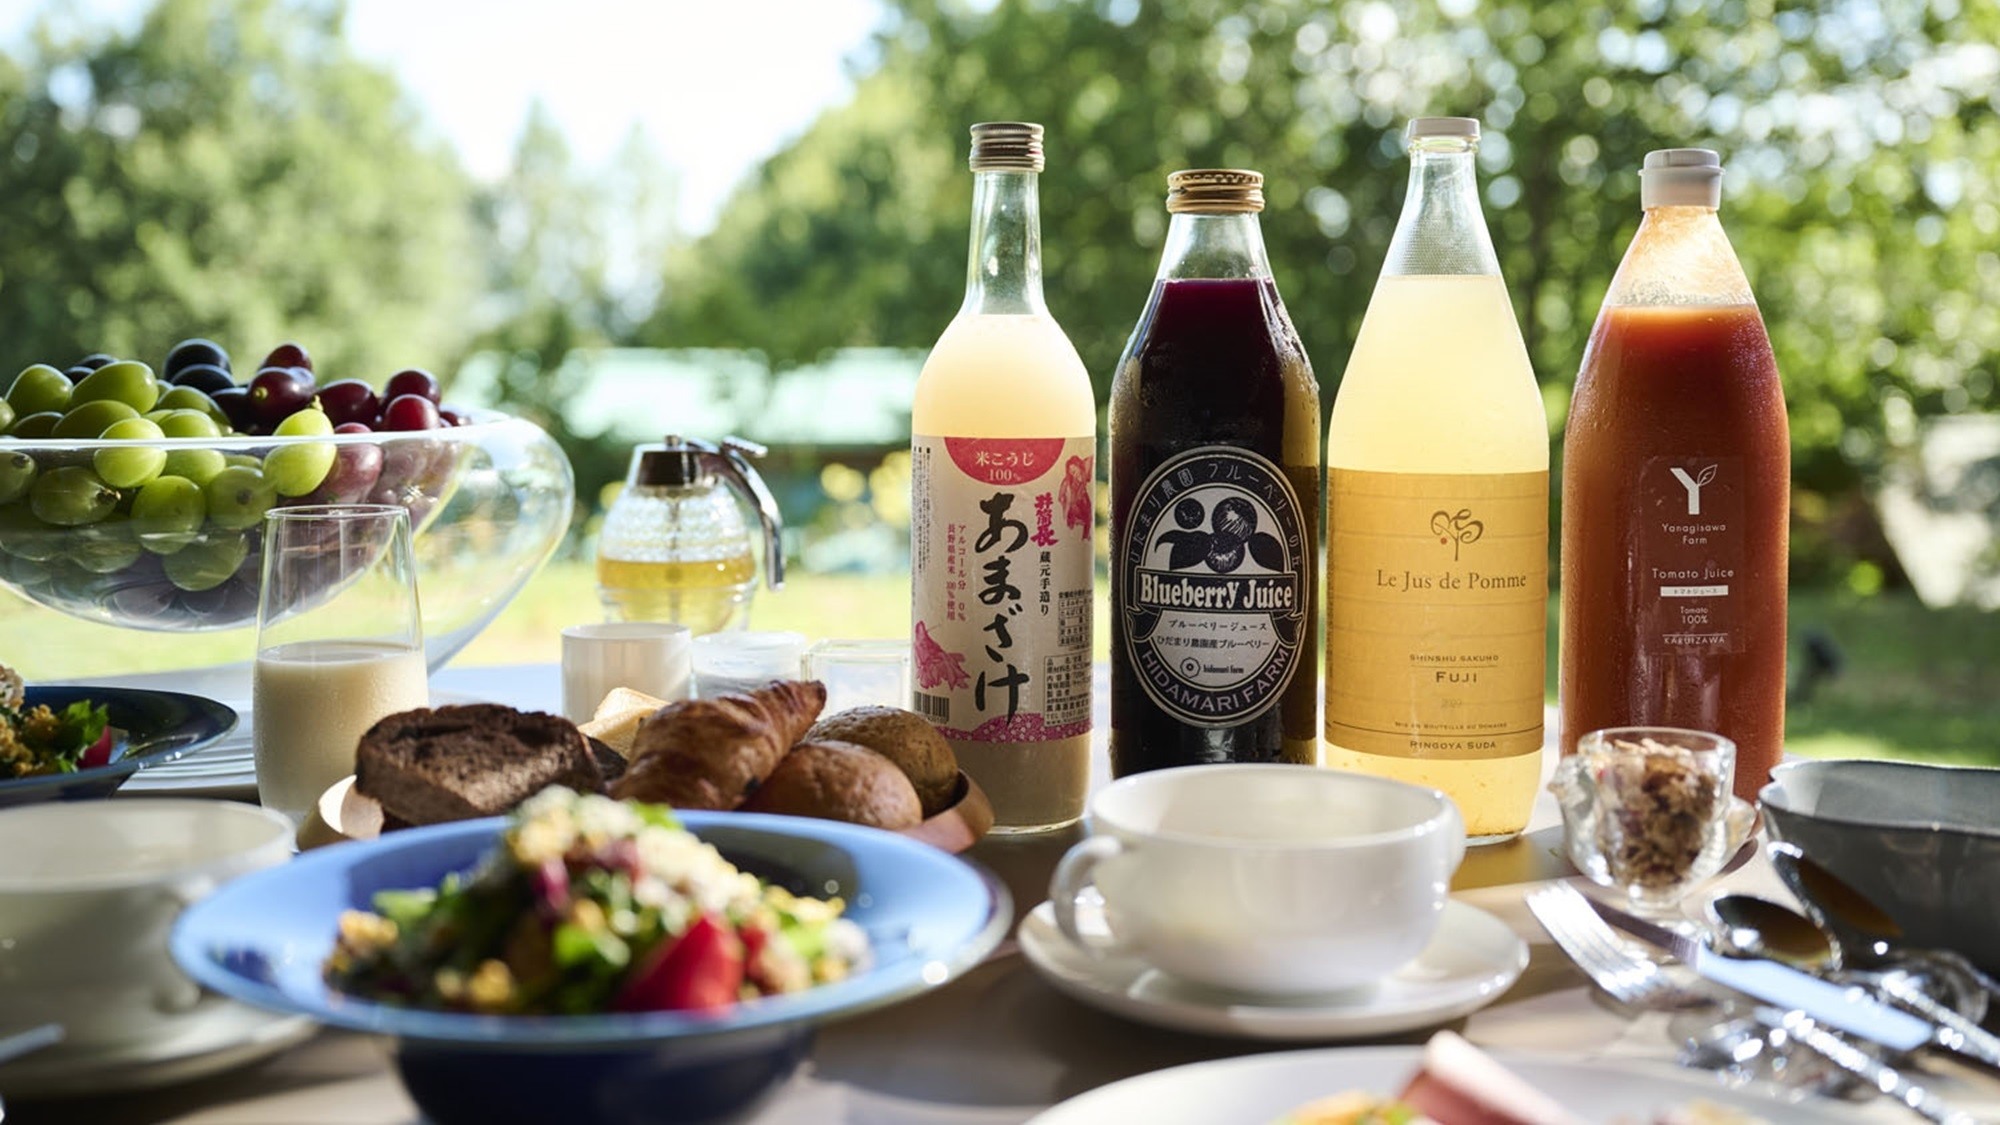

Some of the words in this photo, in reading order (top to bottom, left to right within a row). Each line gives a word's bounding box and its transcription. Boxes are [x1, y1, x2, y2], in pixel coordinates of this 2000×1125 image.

[975, 451, 1034, 467] 米こうじ
[988, 469, 1022, 482] 100%
[1661, 522, 1727, 534] Yanagisawa
[957, 525, 967, 589] アルコール分
[1651, 567, 1699, 579] Tomato
[1704, 567, 1735, 580] Juice
[1039, 551, 1051, 616] 蔵元手造り
[1376, 569, 1397, 587] Le
[1402, 570, 1432, 592] Jus
[1439, 571, 1461, 590] de
[1468, 572, 1527, 590] Pomme
[1243, 579, 1292, 609] Juice
[974, 492, 1030, 726] あまざけ
[1680, 606, 1709, 614] Tomato
[1168, 618, 1267, 632] ブルーベリージュース
[1681, 614, 1709, 624] 100%
[1156, 635, 1270, 649] ひだまり農園産ブルーベリー
[1663, 635, 1726, 645] KARUIZAWA
[1409, 654, 1457, 662] SHINSHU
[1141, 650, 1239, 712] HIDAMARI
[1241, 648, 1290, 703] FARM
[1435, 671, 1478, 683] FUJI
[1409, 740, 1462, 750] RINGOYA
[1467, 740, 1497, 750] SUDA
